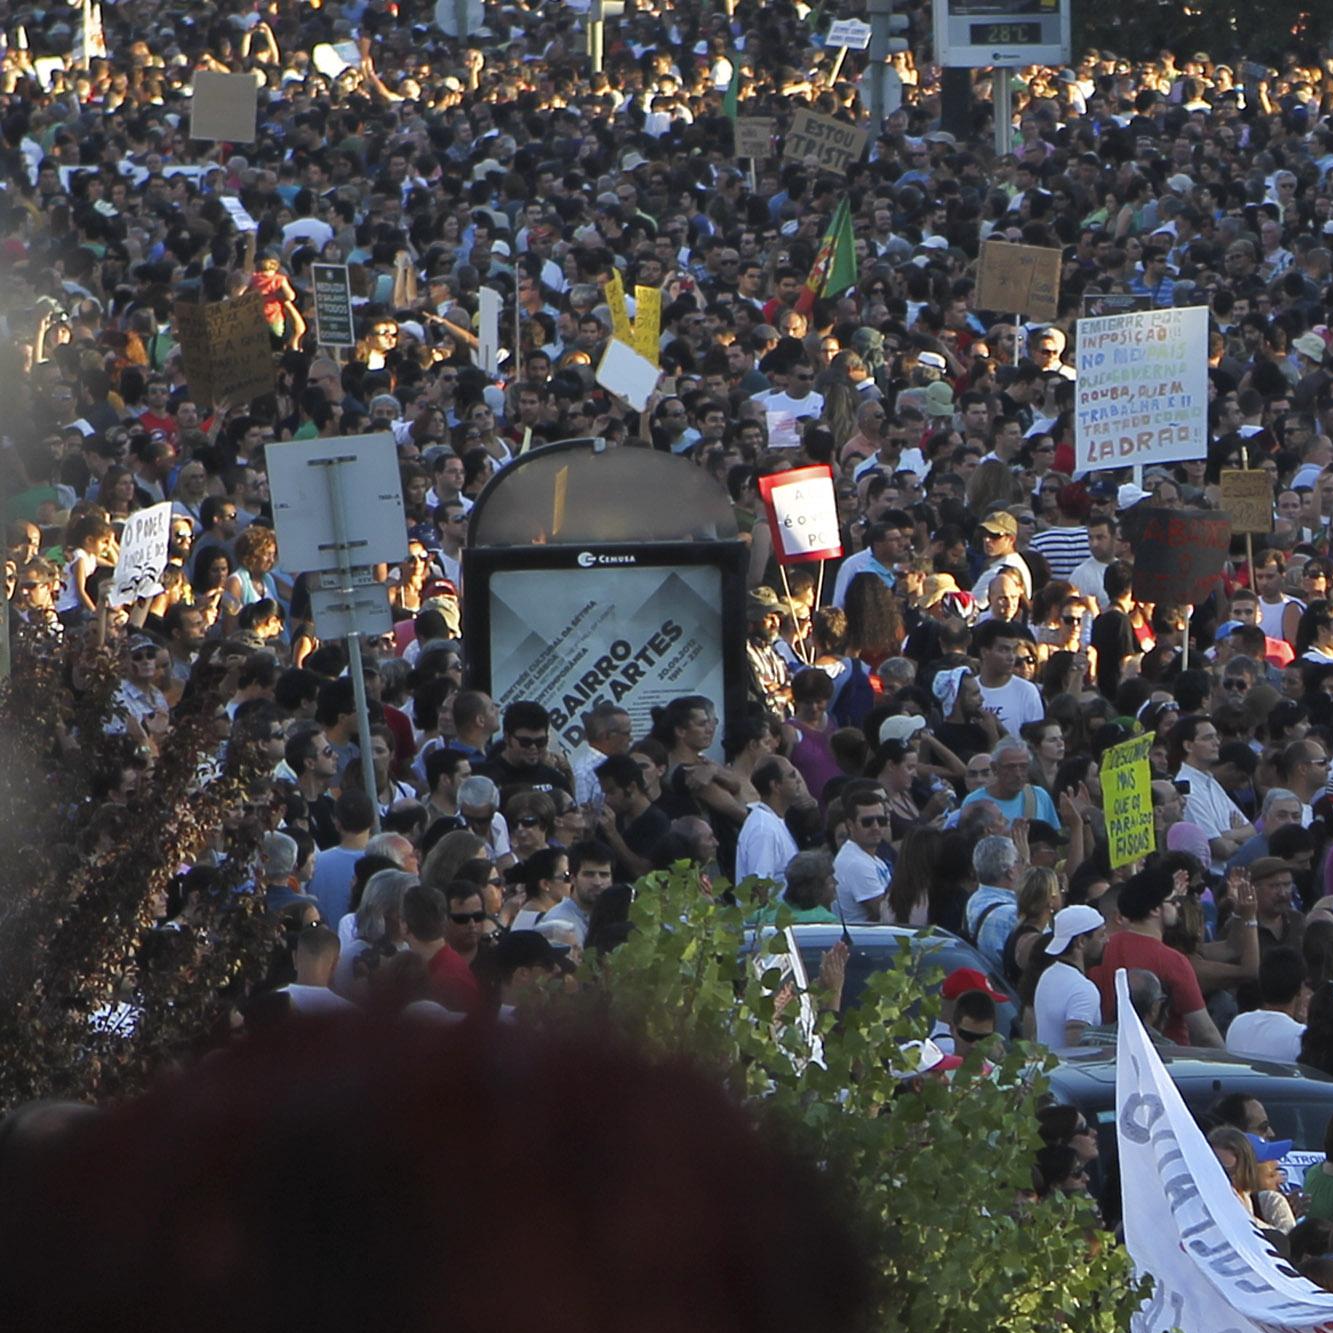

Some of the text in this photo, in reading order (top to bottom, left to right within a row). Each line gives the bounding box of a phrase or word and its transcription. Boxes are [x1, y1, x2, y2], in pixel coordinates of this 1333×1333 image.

[804, 118, 855, 149] ESTOU
[1081, 315, 1145, 334] EMIGRAR
[1082, 353, 1105, 370] NO
[1079, 399, 1160, 424] TRABALHA
[609, 618, 683, 704] ARTES
[551, 639, 632, 730] BAIRRO
